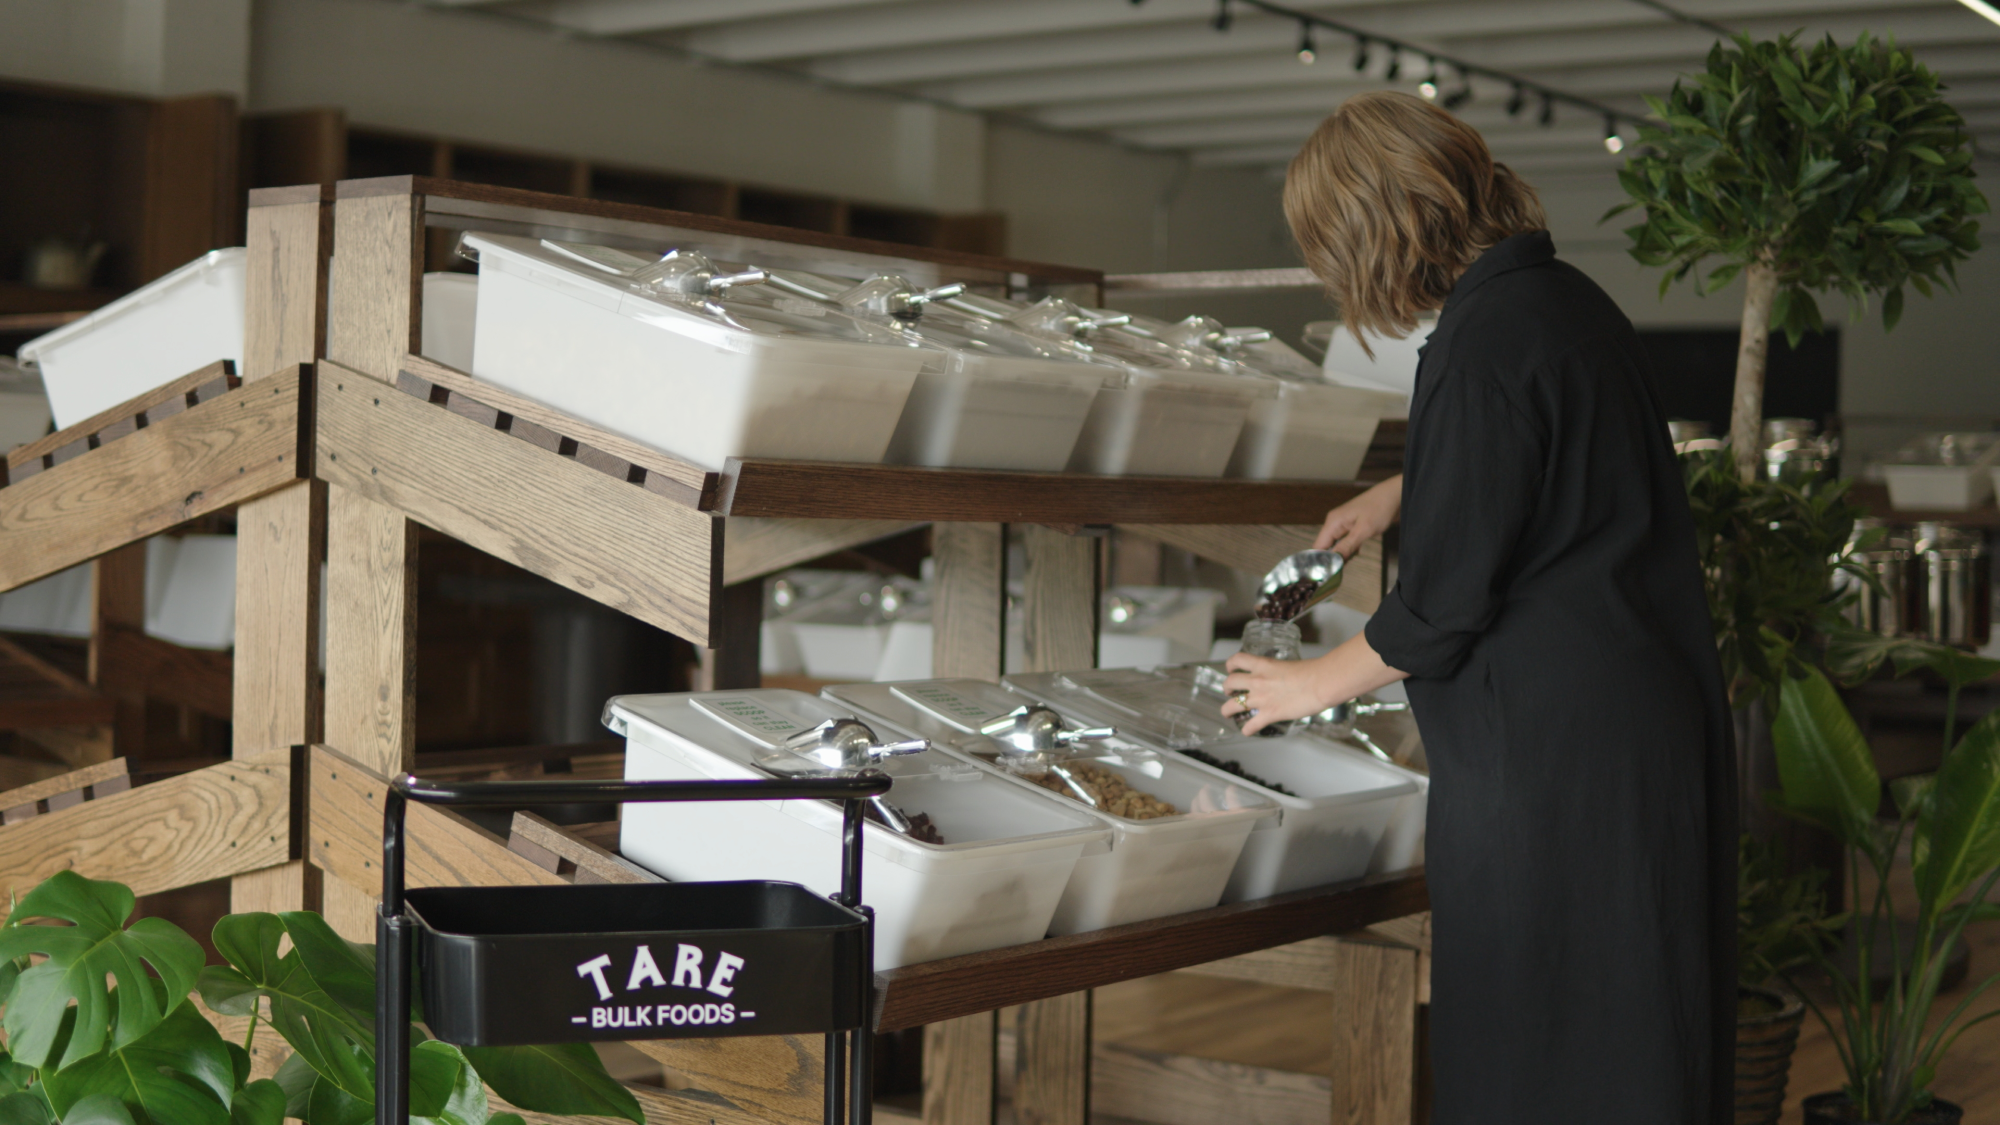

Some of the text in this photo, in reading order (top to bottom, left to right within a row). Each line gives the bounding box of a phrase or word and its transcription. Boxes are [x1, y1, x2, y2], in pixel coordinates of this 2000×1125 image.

[576, 943, 745, 1001] TARE
[591, 1003, 736, 1028] BULK FOODS
